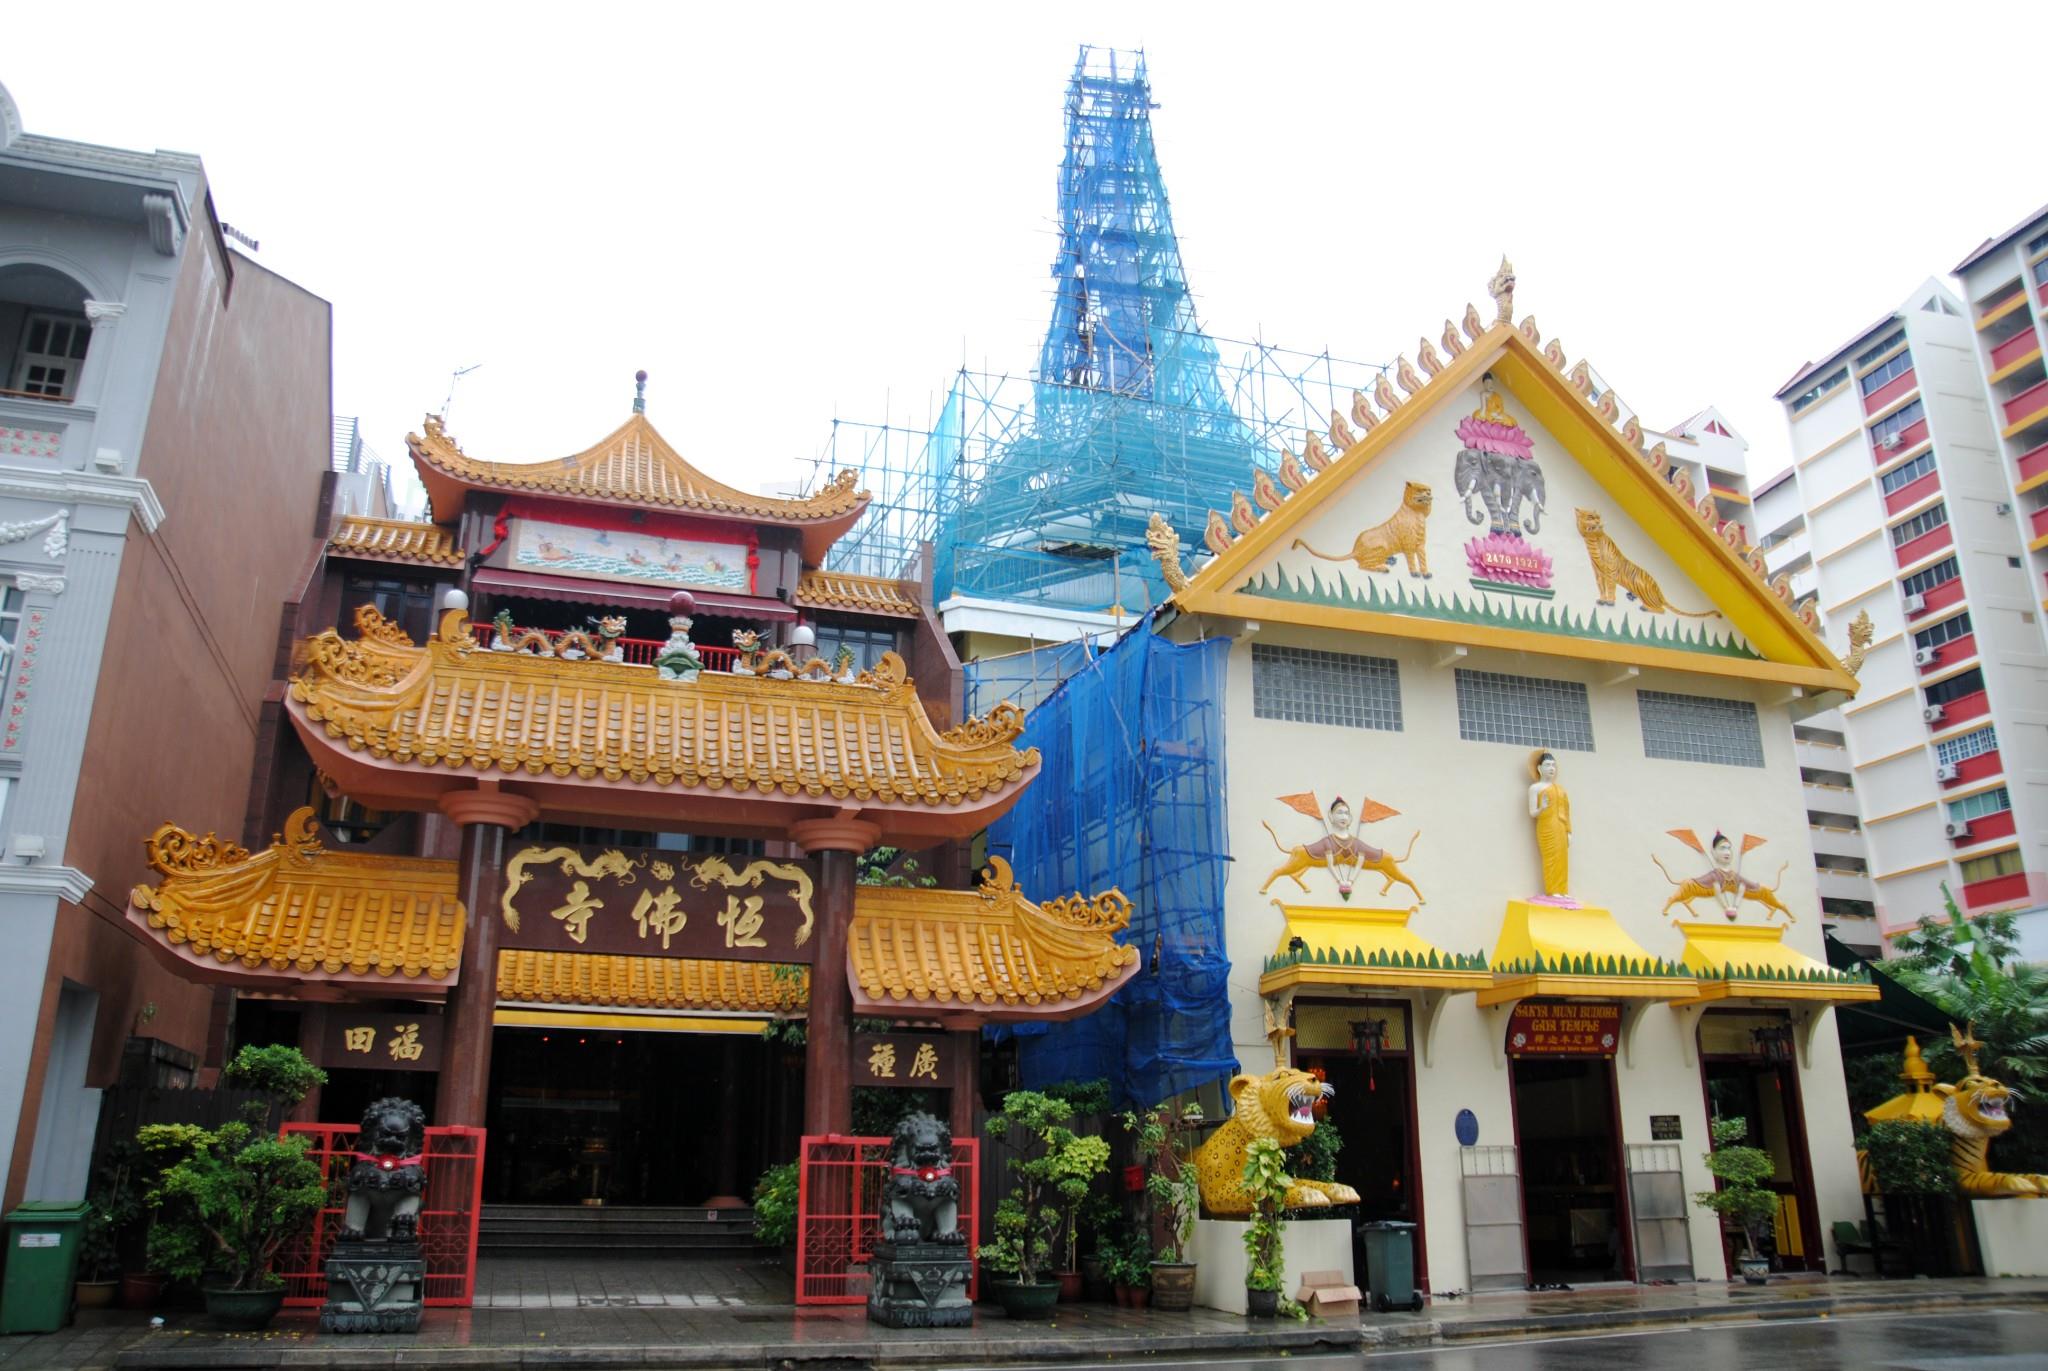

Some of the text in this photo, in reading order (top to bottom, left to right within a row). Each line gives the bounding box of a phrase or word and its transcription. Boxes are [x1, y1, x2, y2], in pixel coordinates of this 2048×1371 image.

[1514, 1005, 1618, 1019] SAKYA MUNI BUDDHA
[1531, 1019, 1600, 1033] GAYA TEMPLE
